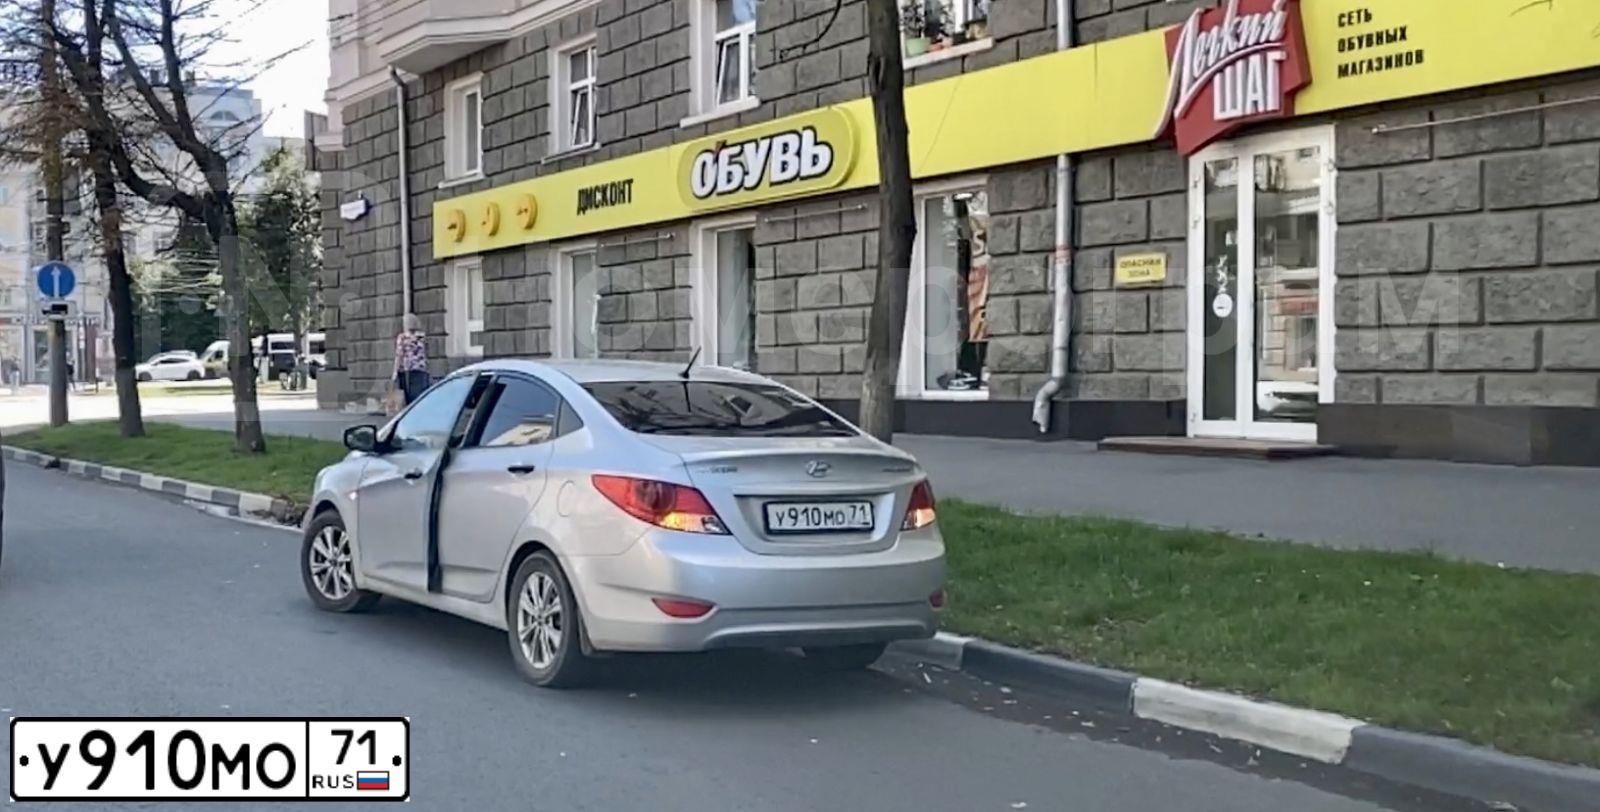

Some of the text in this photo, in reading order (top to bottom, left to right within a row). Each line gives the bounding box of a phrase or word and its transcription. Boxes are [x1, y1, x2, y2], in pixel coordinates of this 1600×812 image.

[1338, 8, 1372, 28] СЕТЬ
[1338, 25, 1407, 53] ОБУВНЫХ
[1338, 49, 1424, 78] МАГАЗИНОВ
[1213, 50, 1287, 121] ШАГ
[690, 126, 834, 199] ОБУВЬ
[577, 178, 634, 216] ДИСКОНТ
[775, 504, 867, 527] У910МО 71
